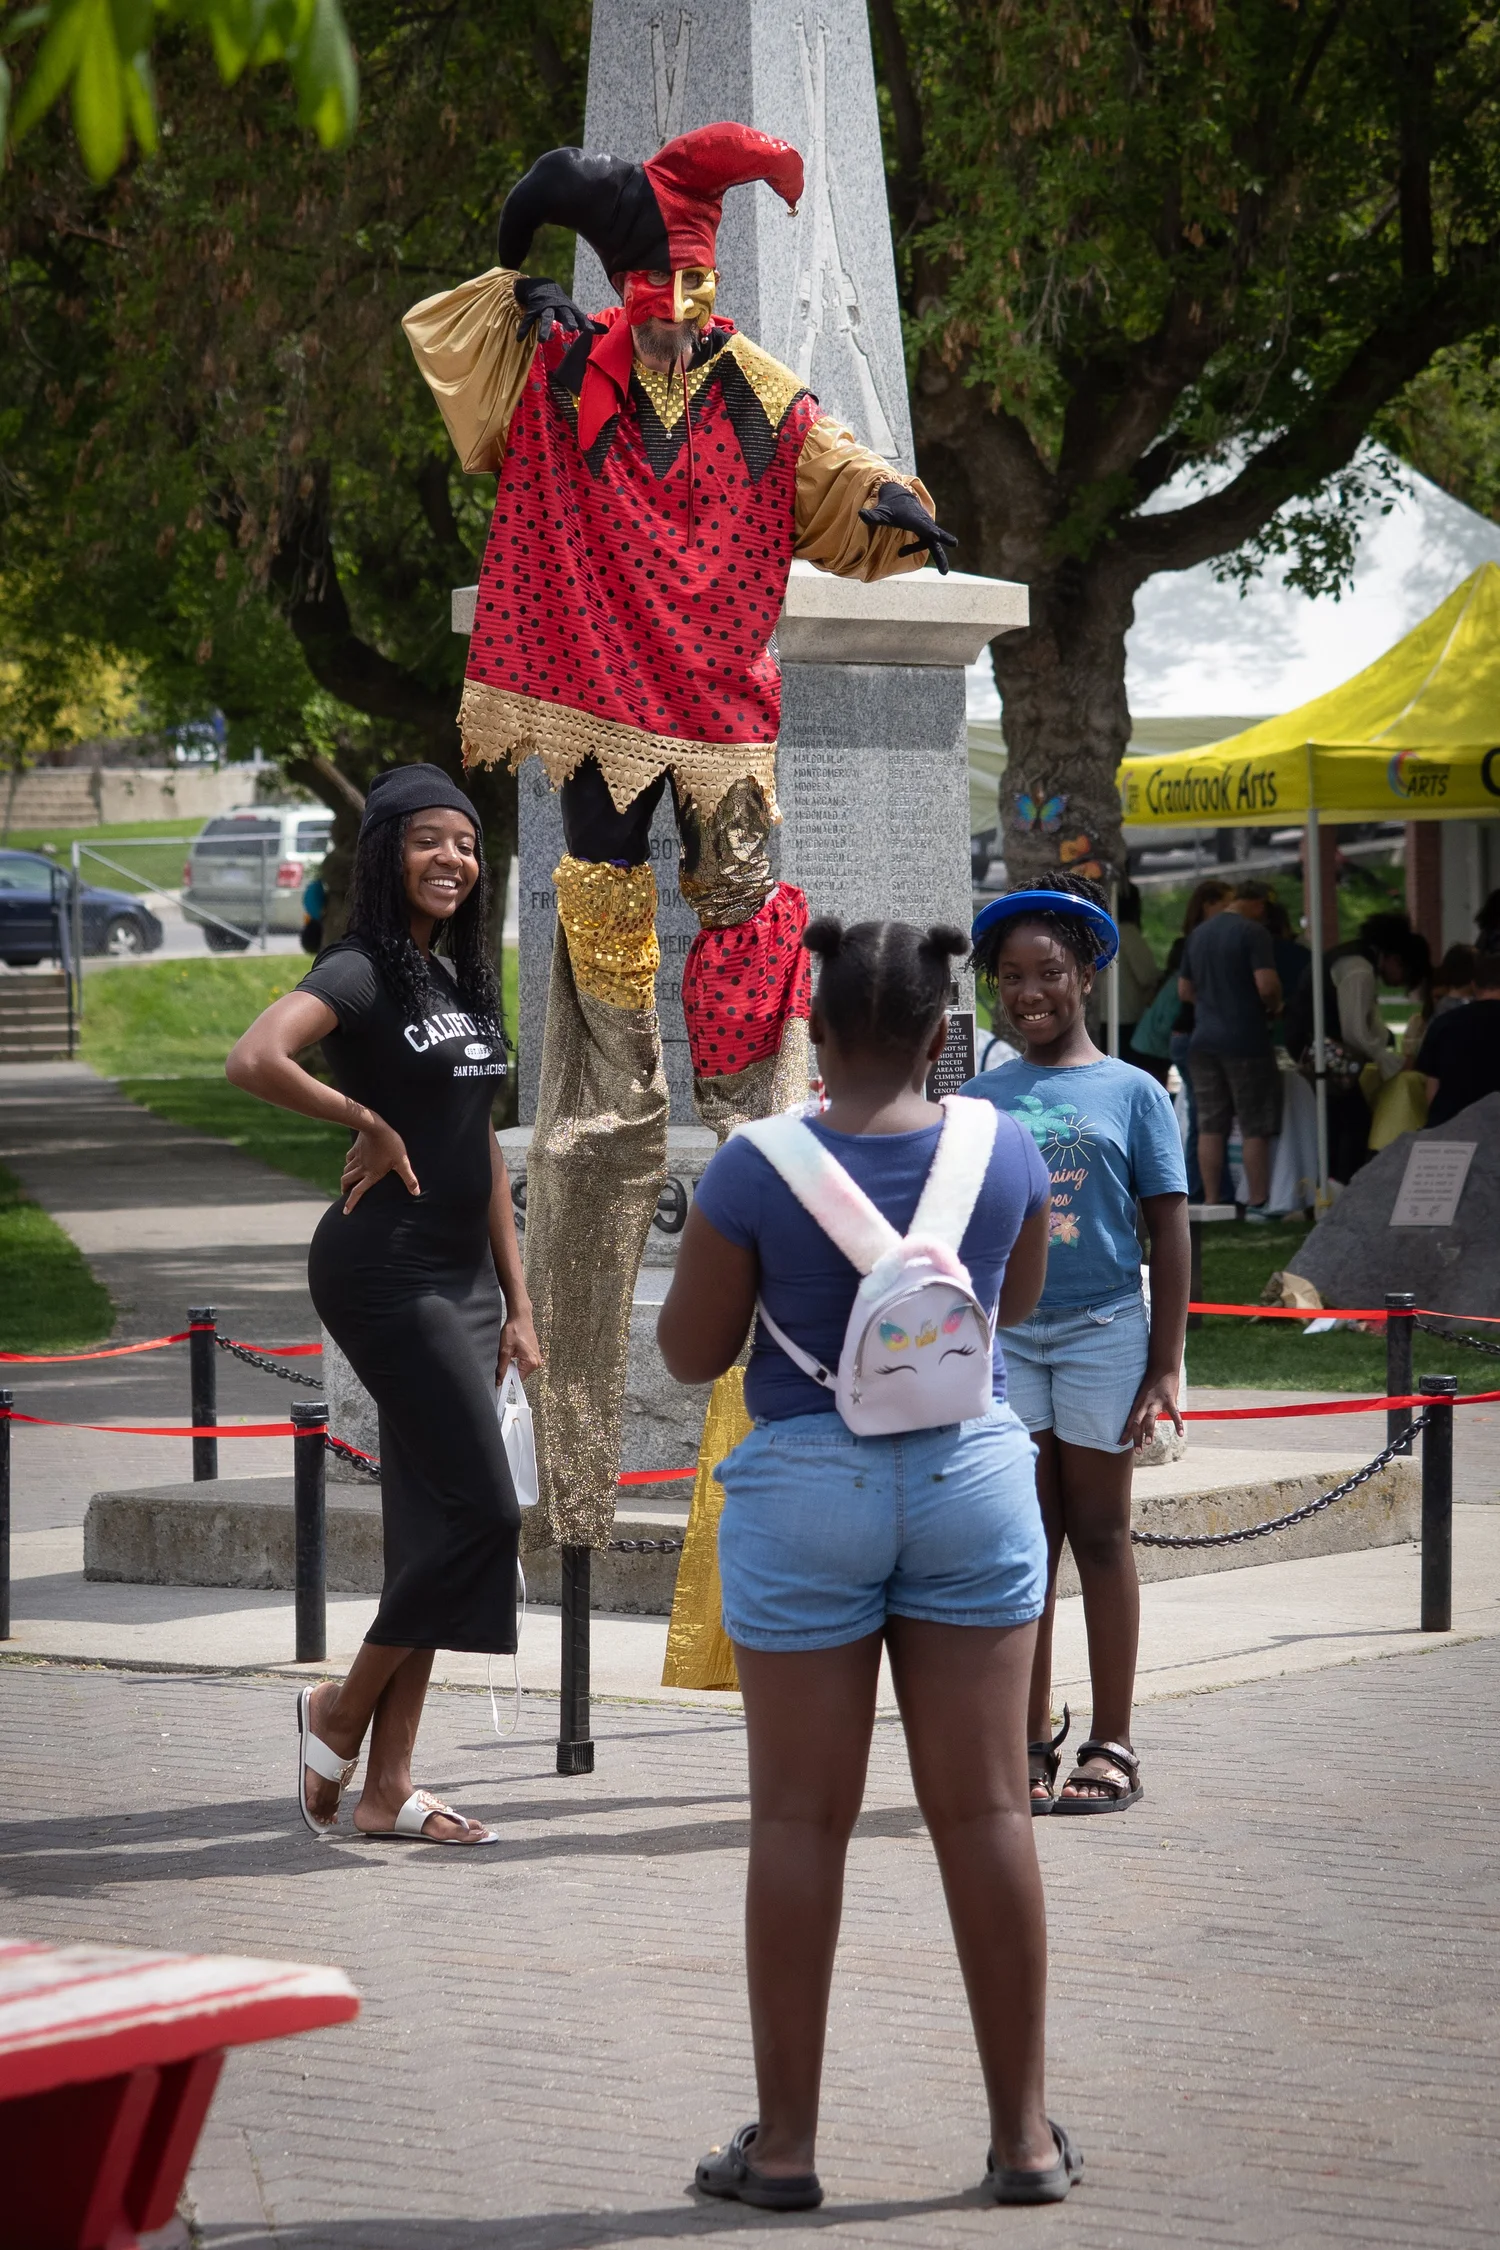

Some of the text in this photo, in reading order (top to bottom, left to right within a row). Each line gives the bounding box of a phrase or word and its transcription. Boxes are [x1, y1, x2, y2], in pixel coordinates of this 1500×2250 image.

[1146, 762, 1278, 814] Cranbrook Arts
[1406, 774, 1448, 798] ARTS
[453, 1066, 468, 1077] SAN
